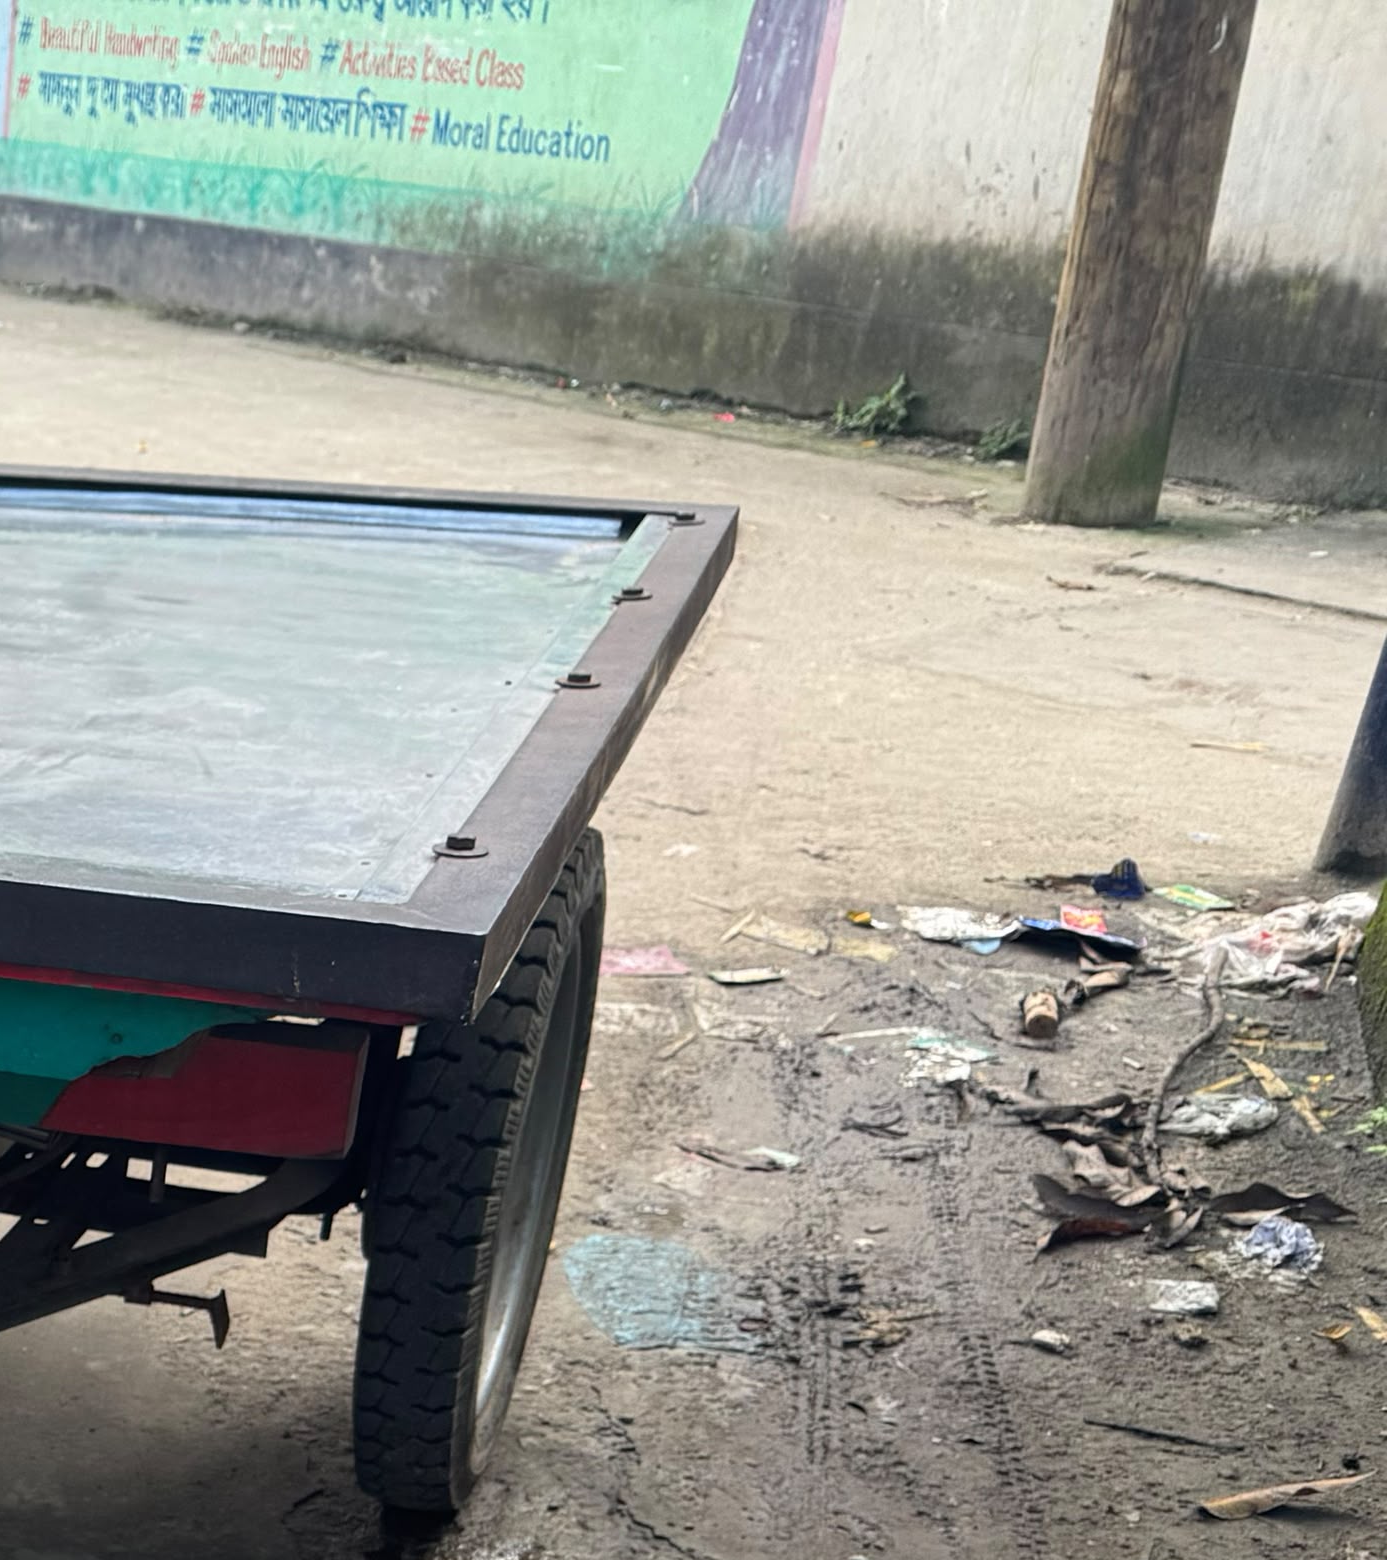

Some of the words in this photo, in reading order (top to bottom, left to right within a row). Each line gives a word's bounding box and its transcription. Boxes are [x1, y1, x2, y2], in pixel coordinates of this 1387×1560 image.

[39, 16, 101, 53] Beautiful
[104, 21, 180, 69] Handwriting
[209, 29, 257, 74] Spoken
[259, 33, 312, 79] English
[338, 39, 417, 80] Activities
[475, 49, 526, 90] Class
[431, 107, 491, 152] Moral
[495, 114, 612, 163] Education
